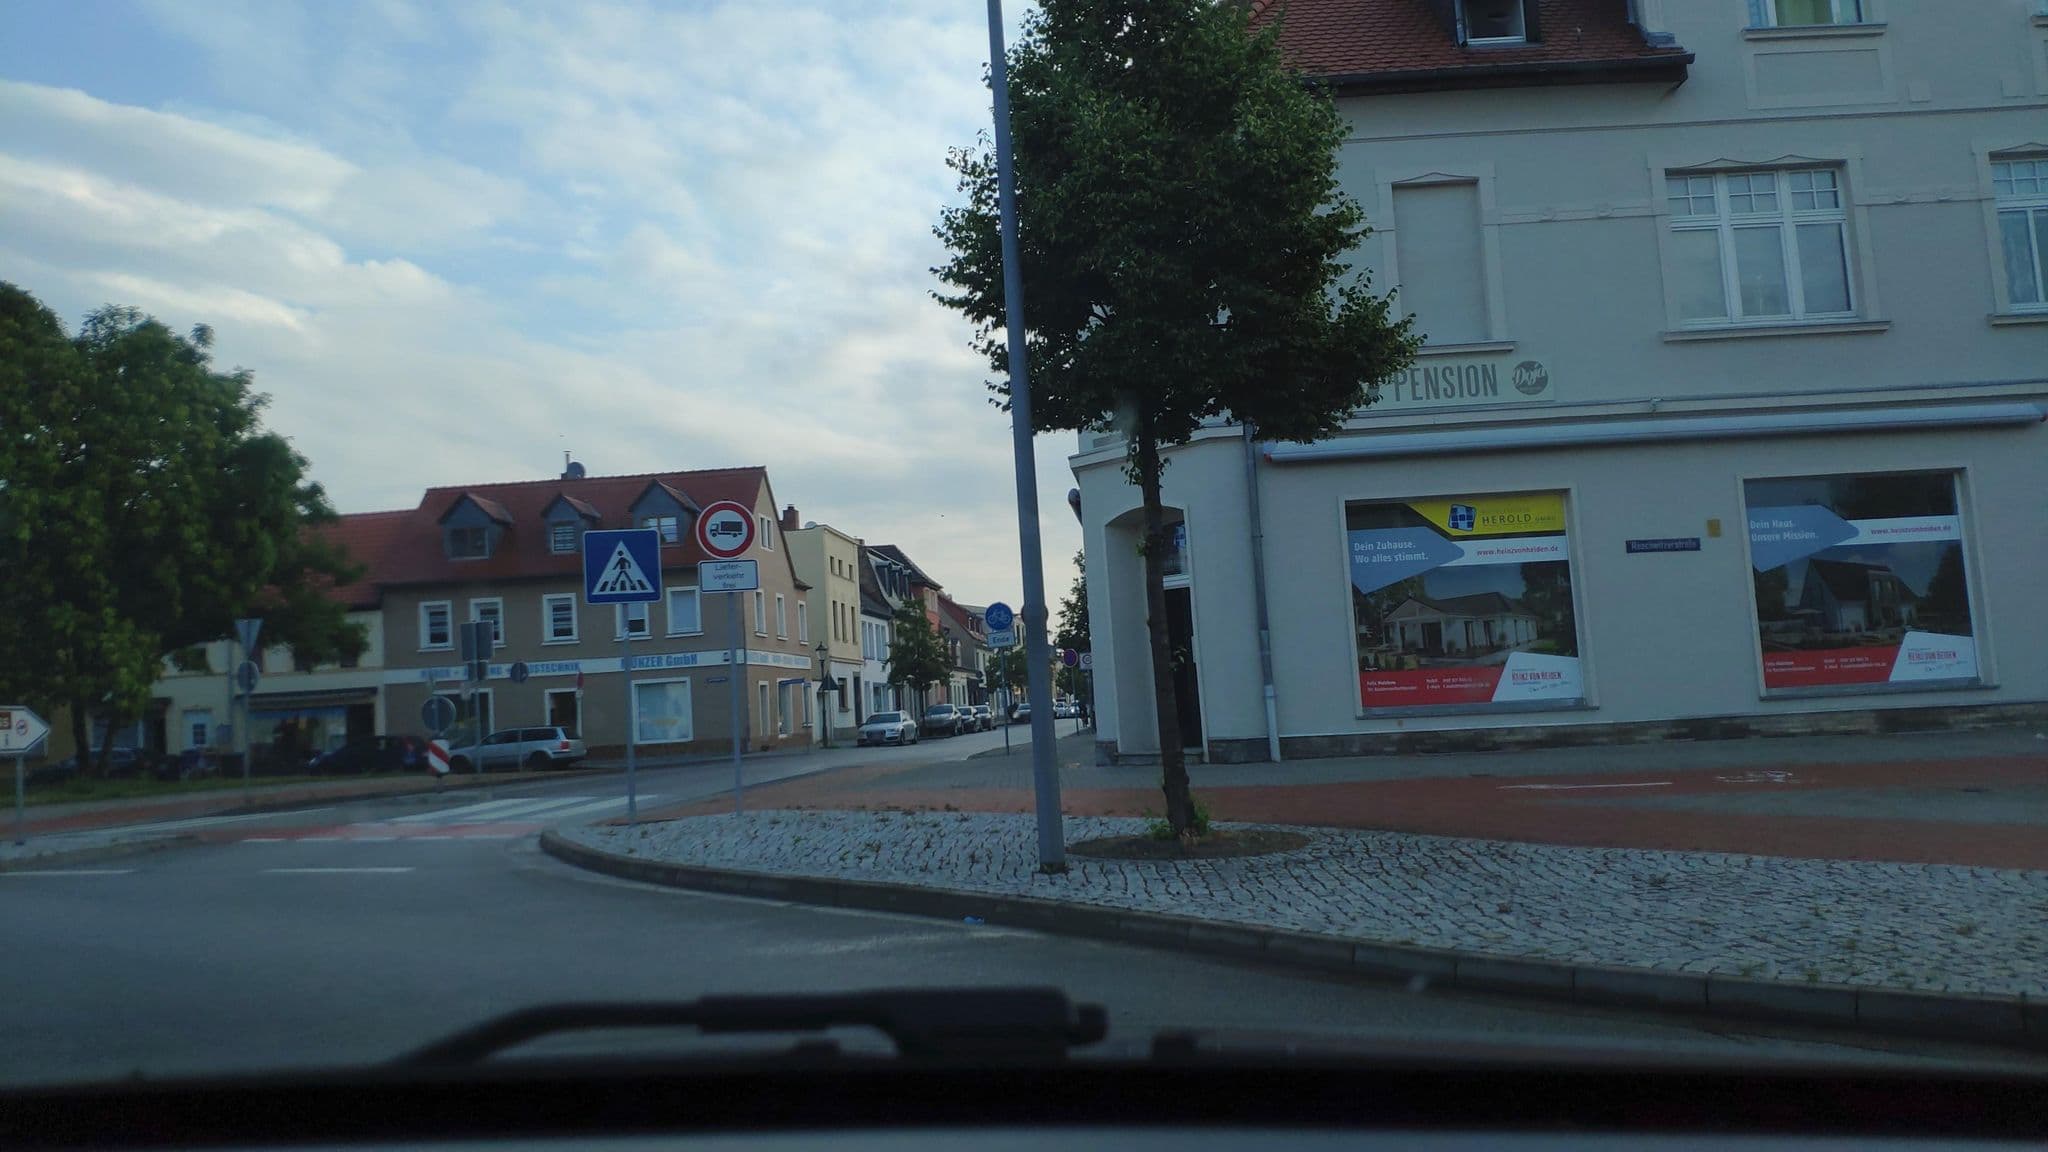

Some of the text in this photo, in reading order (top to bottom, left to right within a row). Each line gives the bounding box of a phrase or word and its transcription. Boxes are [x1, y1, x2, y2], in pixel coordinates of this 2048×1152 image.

[1394, 364, 1499, 402] PENSION
[1482, 513, 1532, 525] HEROLD
[1750, 520, 1770, 529] Dein
[1751, 532, 1781, 541] Unsere
[1354, 540, 1416, 551] Dein Zuhause.
[1355, 551, 1429, 563] Wo alles stimmt.
[993, 636, 1010, 644] Ende
[666, 653, 698, 667] GmbH
